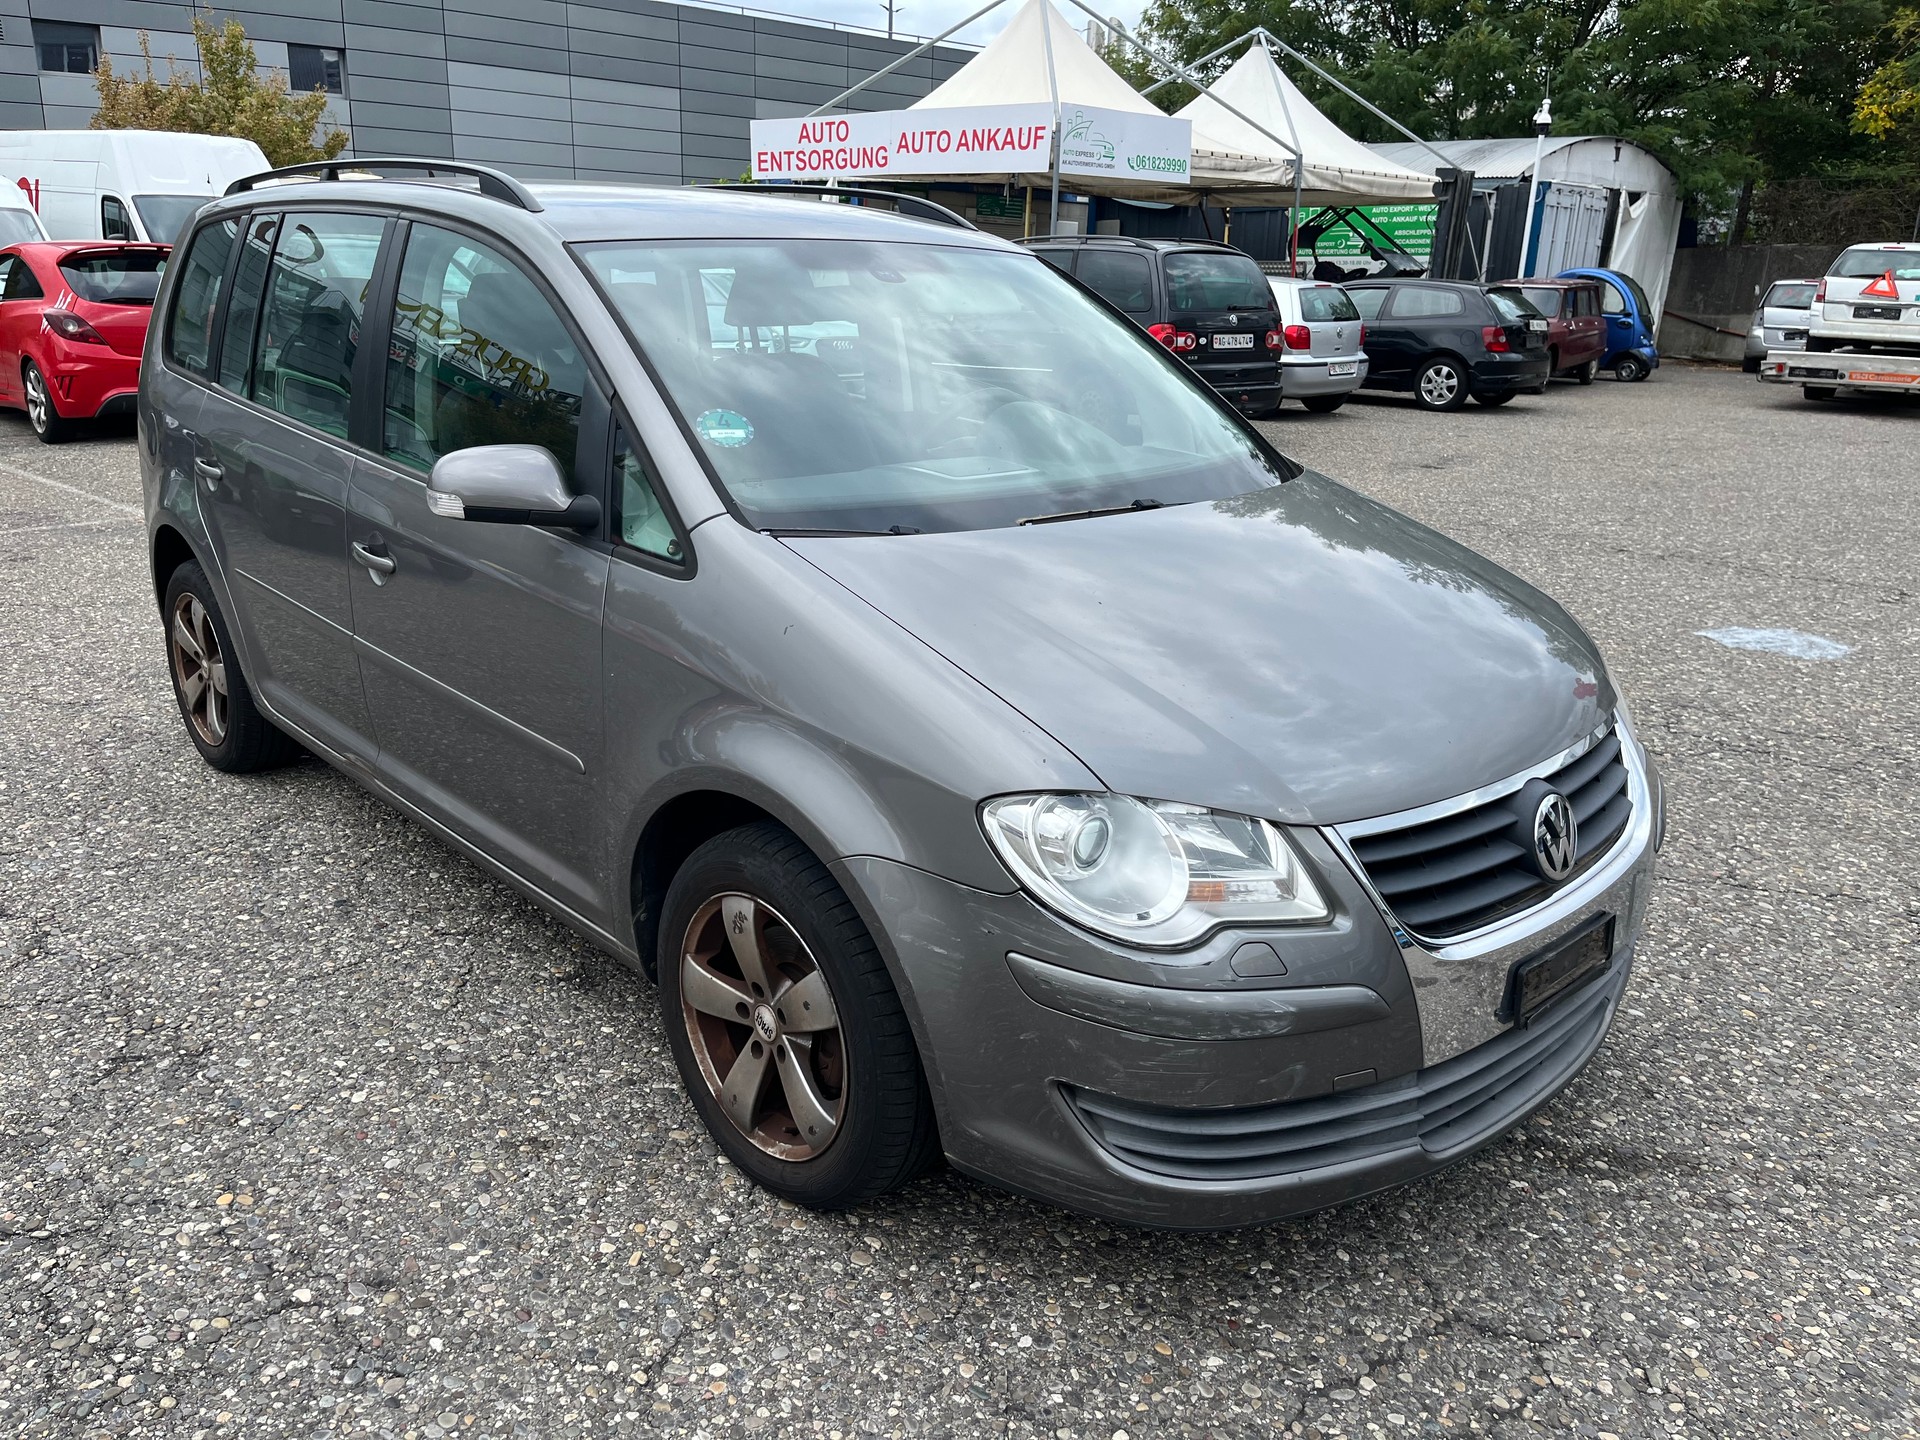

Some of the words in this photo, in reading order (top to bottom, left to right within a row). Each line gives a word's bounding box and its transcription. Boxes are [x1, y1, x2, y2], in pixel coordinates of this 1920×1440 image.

[798, 120, 849, 144] AUTO
[896, 129, 951, 154] AUTO
[955, 126, 1046, 152] ANKAUF
[757, 145, 888, 172] ENTSORGUNG
[1075, 150, 1095, 158] EXPRESS
[1136, 155, 1187, 172] 0618239990
[718, 414, 731, 427] 4
